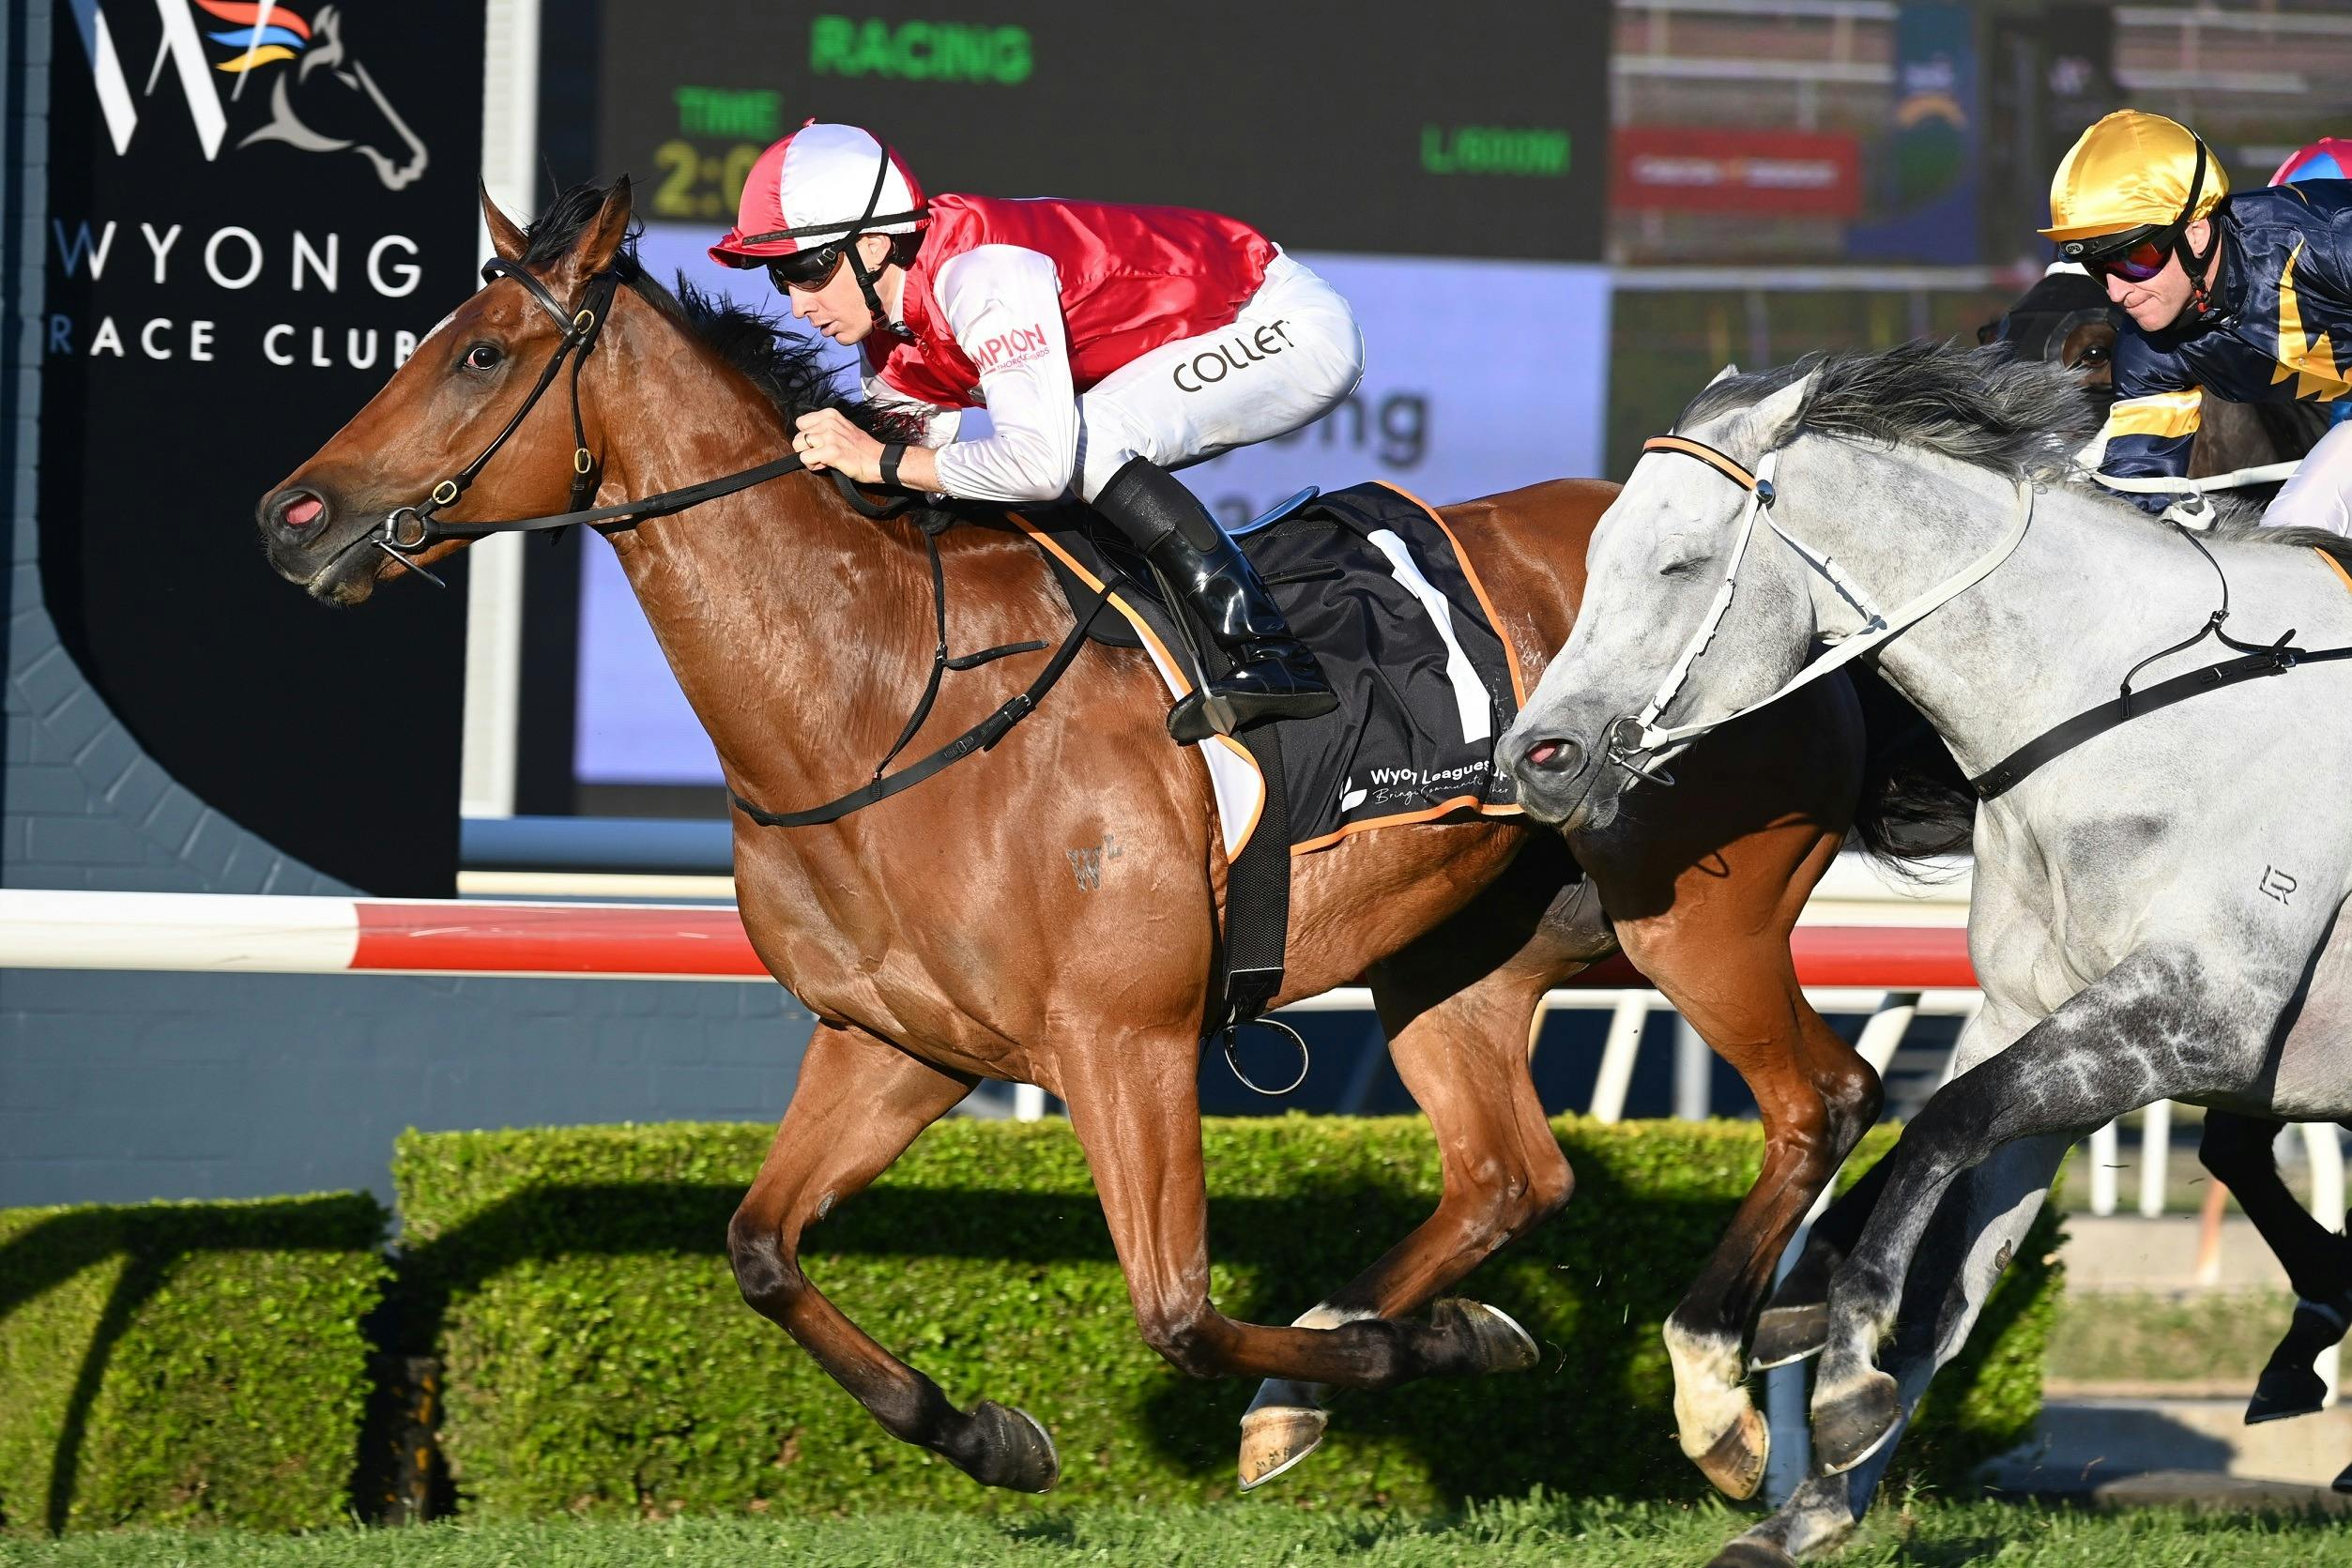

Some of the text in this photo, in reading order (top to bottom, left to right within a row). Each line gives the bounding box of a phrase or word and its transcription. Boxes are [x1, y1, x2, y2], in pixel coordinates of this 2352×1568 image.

[809, 14, 1032, 85] RACING
[674, 85, 780, 142] TIME
[53, 218, 422, 297] WYONG
[50, 313, 216, 362] RACE
[970, 323, 1046, 373] MPION
[1173, 319, 1294, 392] COLLET
[1367, 528, 1491, 744] 1
[1421, 760, 1490, 784] Leagues
